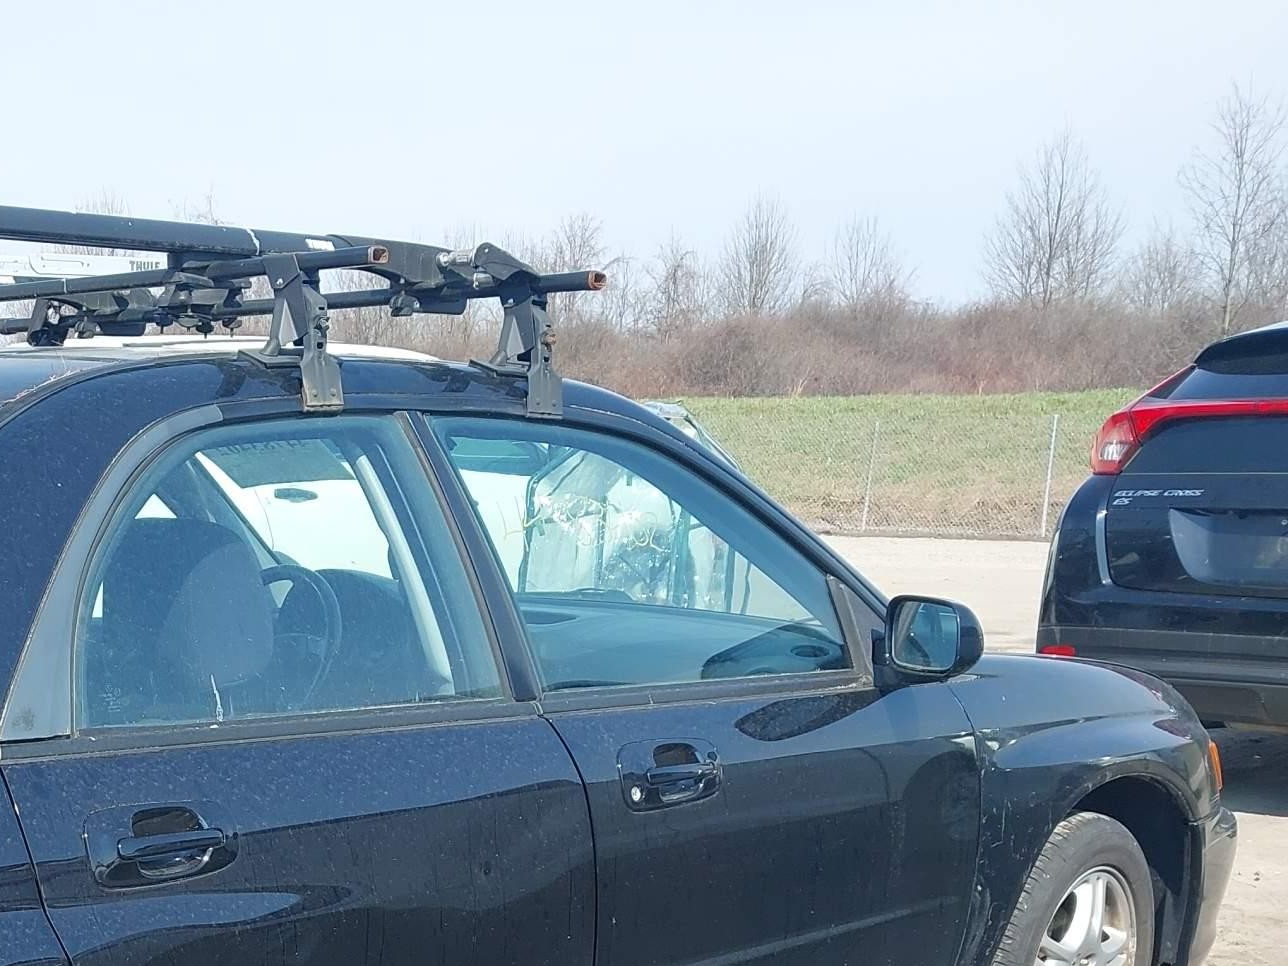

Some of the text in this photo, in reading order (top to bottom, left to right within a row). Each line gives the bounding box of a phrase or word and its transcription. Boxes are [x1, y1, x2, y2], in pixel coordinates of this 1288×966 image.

[1113, 489, 1205, 497] ECLIPSE CROSS
[1112, 497, 1133, 505] ES
